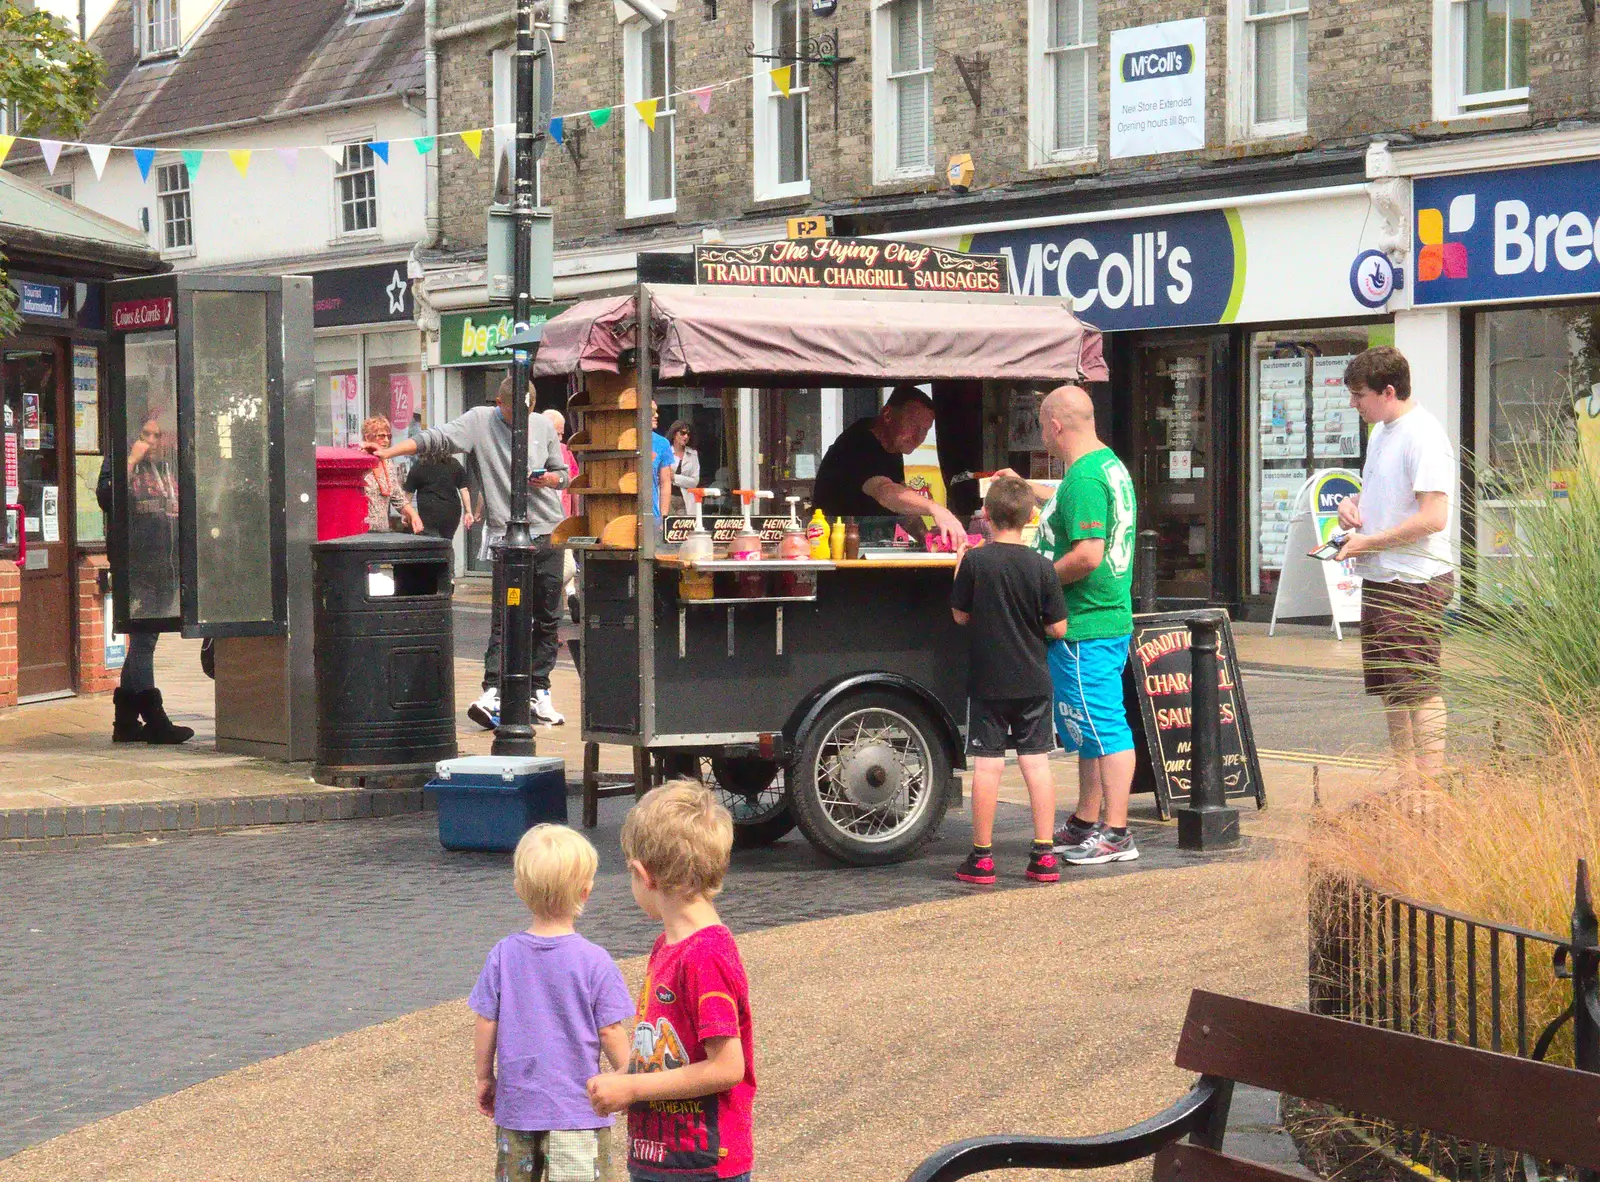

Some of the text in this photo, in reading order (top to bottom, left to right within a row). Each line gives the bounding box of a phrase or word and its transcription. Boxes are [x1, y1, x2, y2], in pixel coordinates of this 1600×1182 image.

[1131, 51, 1183, 77] McColl's
[1122, 97, 1192, 114] New Store Extended
[1117, 121, 1145, 133] Opening
[1147, 117, 1168, 128] hours
[1169, 115, 1177, 126] till
[1494, 199, 1600, 275] Bre
[770, 238, 932, 270] The Flying Chef
[702, 263, 1001, 292] TRADITIONAL CHARGRILL SAUSAGES
[1000, 231, 1193, 312] McColl's
[24, 285, 42, 298] Tourist
[115, 308, 133, 326] Coins
[139, 304, 161, 323] Cards
[672, 519, 697, 530] CORN
[713, 519, 745, 530] BURGE
[763, 519, 792, 529] HEINZ
[668, 530, 689, 541] RELI
[713, 530, 737, 541] RELI
[1164, 760, 1186, 773] OUR
